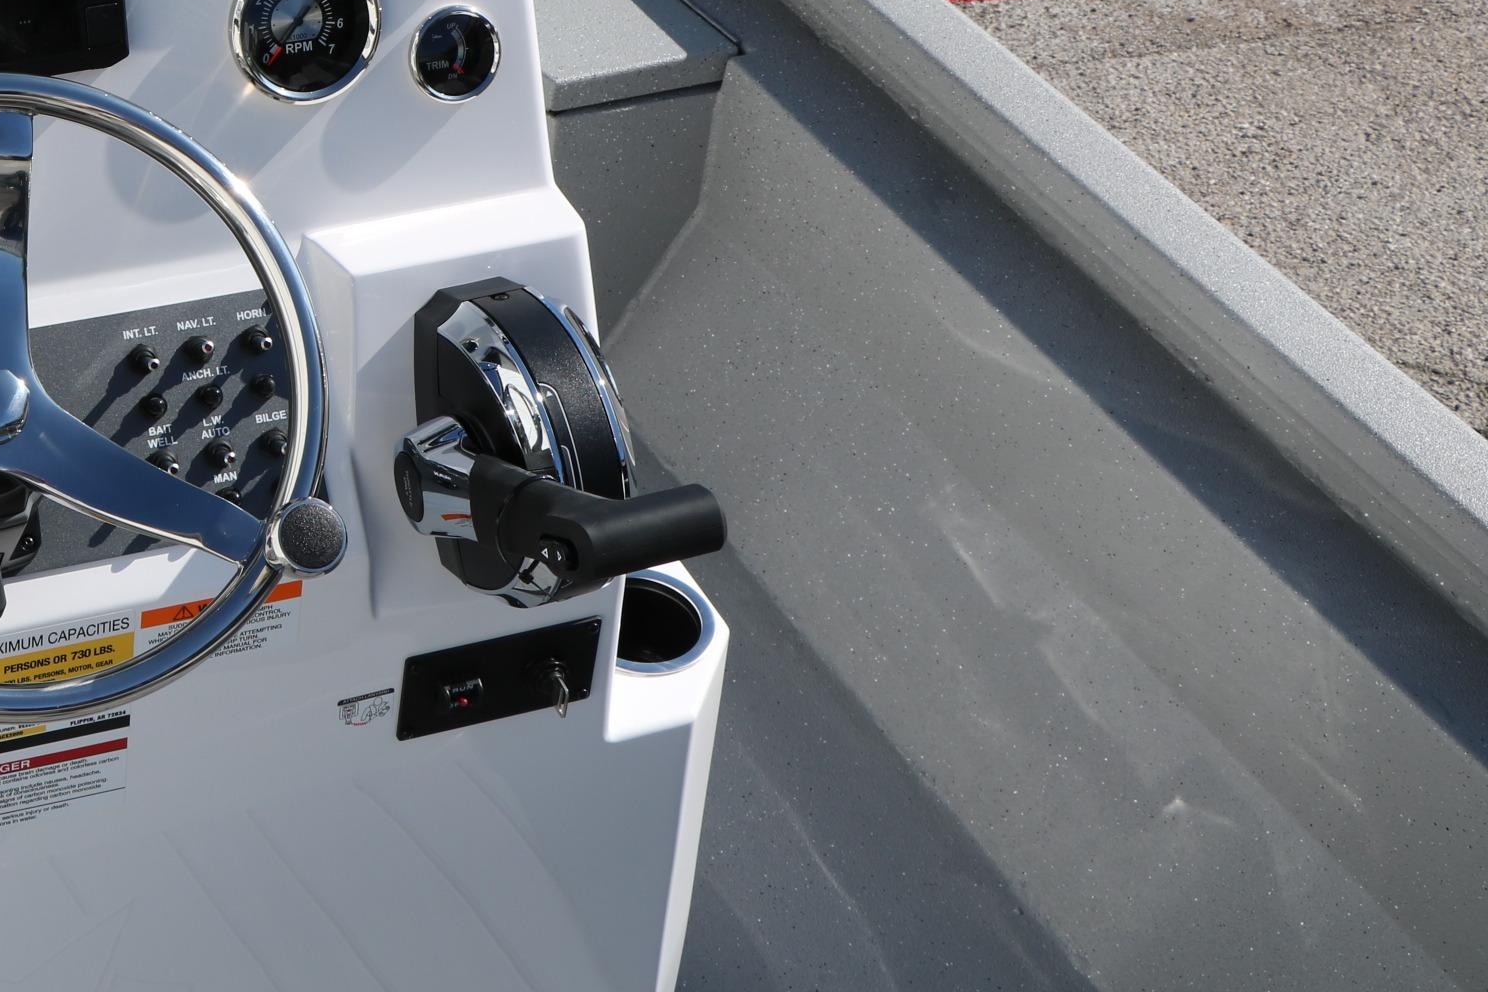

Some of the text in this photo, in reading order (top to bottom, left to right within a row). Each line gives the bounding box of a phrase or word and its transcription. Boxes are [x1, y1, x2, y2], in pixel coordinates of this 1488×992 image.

[337, 18, 343, 28] 6
[286, 41, 312, 54] RPM
[328, 44, 335, 54] 7
[426, 60, 449, 71] TRIM
[236, 308, 266, 321] HORN
[177, 317, 216, 331] NAV. LT.
[123, 325, 158, 340] INT. LT.
[182, 366, 230, 381] ANCH. LT.
[203, 415, 224, 427] L.W.
[255, 410, 288, 424] BILGE
[148, 424, 172, 436] BAIT
[201, 426, 231, 440] AUTO
[147, 436, 178, 449] WELL
[213, 471, 238, 484] MAN
[48, 617, 129, 644] CAPACITIES
[240, 624, 282, 636] ATTEMPTING
[223, 641, 252, 651] MANUAL
[253, 637, 267, 645] FOR
[4, 657, 50, 674] PERSONS
[53, 653, 66, 664] OR
[71, 648, 90, 660] 730
[94, 644, 115, 656] LBS.
[95, 658, 113, 667] GEAR
